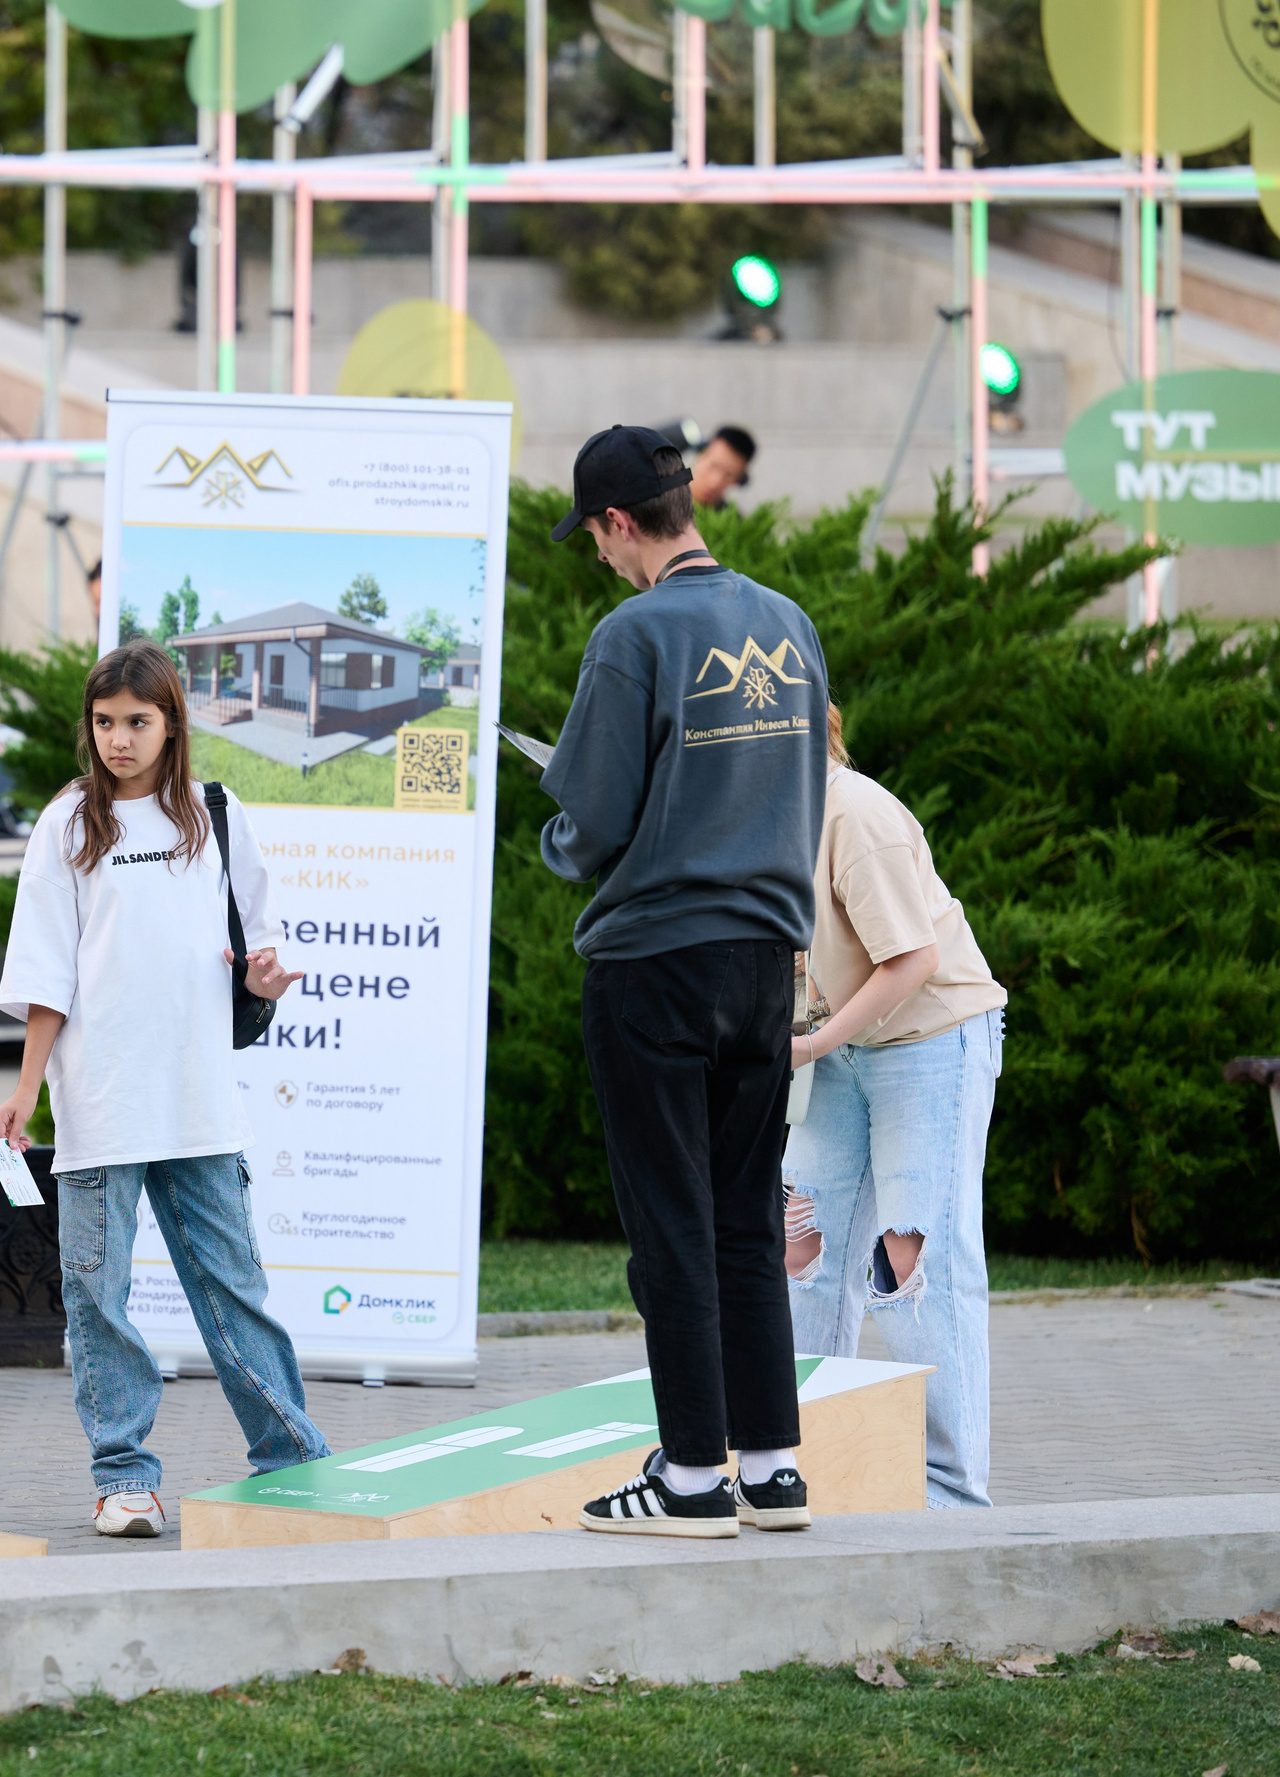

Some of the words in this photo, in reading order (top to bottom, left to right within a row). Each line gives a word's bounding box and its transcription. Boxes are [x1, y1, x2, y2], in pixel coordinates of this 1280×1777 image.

[1110, 410, 1217, 450] ТУТ
[112, 855, 129, 866] JIL
[326, 843, 456, 863] компания
[280, 869, 370, 890] «КИК»
[300, 972, 411, 1002] цене
[306, 1081, 366, 1094] Гарантия
[369, 1083, 376, 1095] 5
[379, 1085, 401, 1096] лет
[306, 1098, 322, 1108] по
[324, 1098, 384, 1112] договору
[304, 1150, 442, 1166] Квалифицированные
[303, 1165, 358, 1178] бригады
[301, 1211, 406, 1226] Круглогодичное
[301, 1226, 395, 1240] строительство
[146, 1276, 182, 1287] Росто
[131, 1290, 188, 1302] Кондауро
[358, 1294, 436, 1309] Домклик
[407, 1314, 437, 1324] СБЕР
